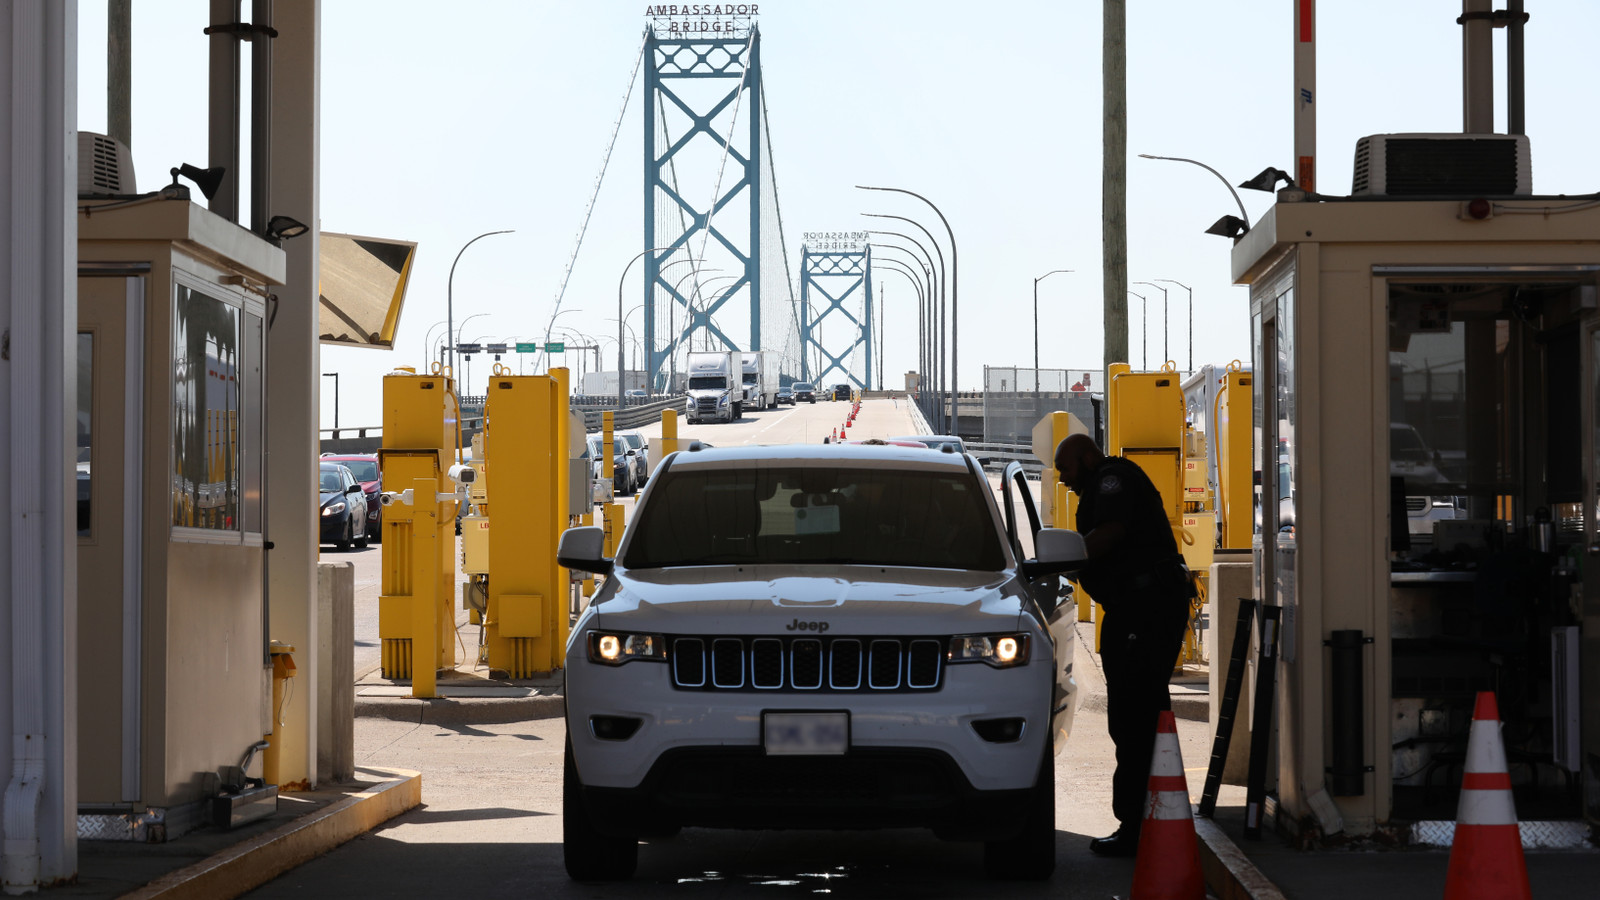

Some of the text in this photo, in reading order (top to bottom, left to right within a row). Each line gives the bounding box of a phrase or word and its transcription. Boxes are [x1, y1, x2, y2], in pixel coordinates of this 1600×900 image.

[646, 4, 759, 16] AMBASSADOR
[671, 21, 733, 32] BRIDGE
[786, 618, 830, 633] Jeep
